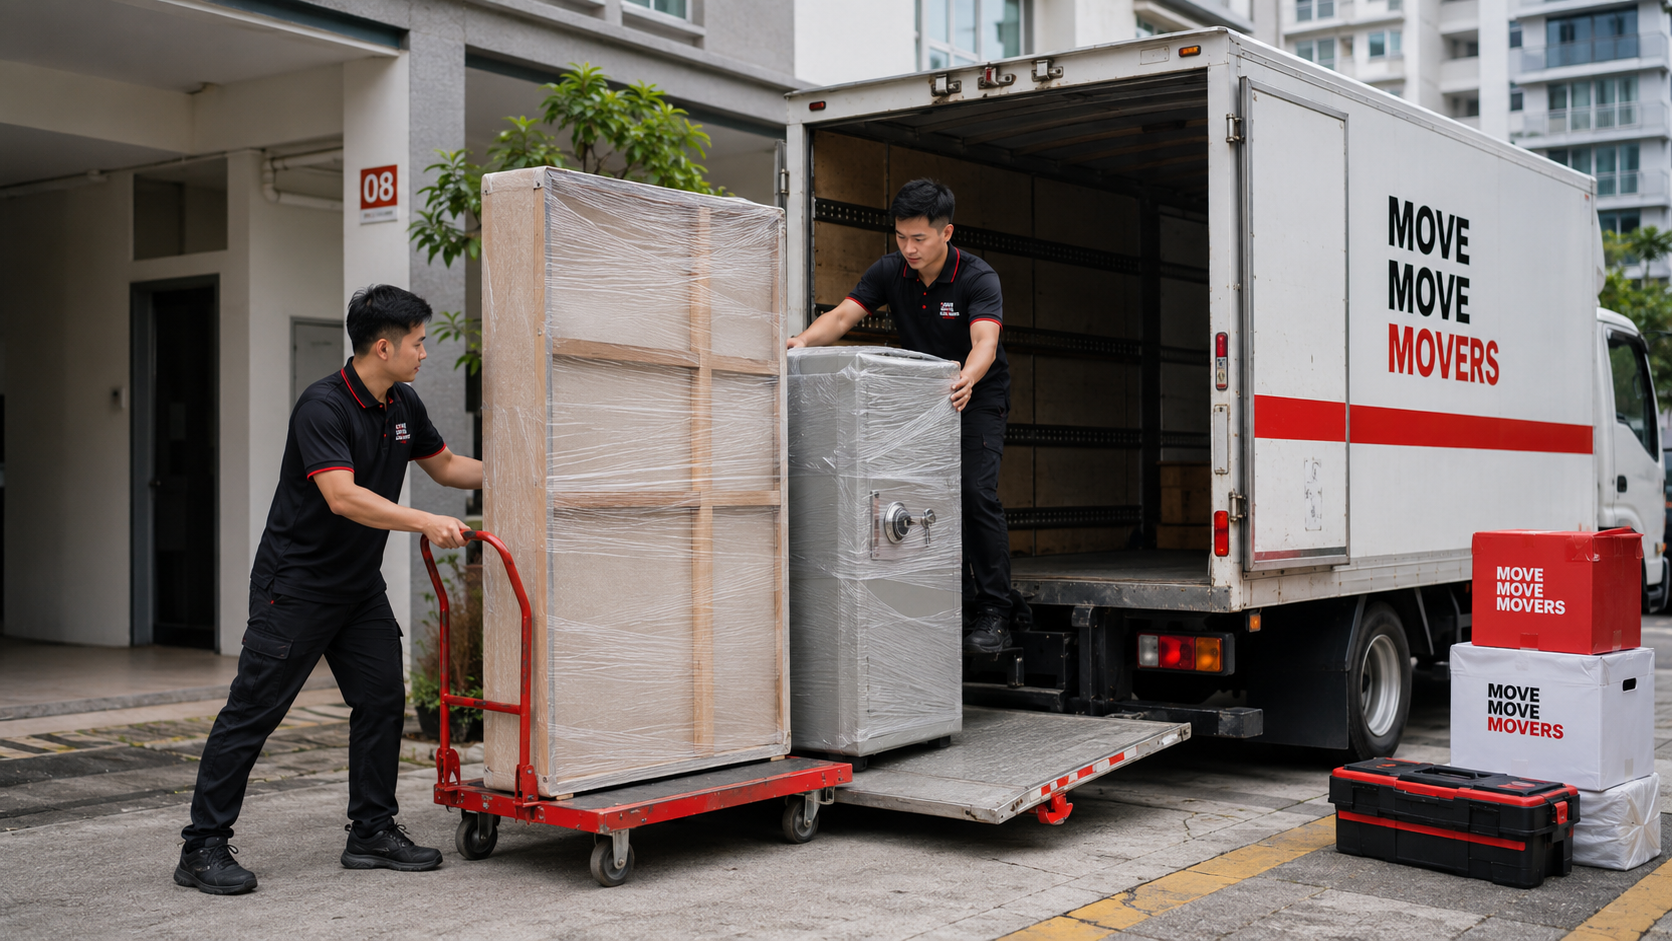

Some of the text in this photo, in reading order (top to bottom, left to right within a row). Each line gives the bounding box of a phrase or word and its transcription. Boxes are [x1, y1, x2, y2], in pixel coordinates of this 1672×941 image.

[363, 171, 394, 204] 08
[1388, 195, 1470, 265] MOVE
[1388, 259, 1470, 324] MOVE
[1388, 323, 1500, 386] MOVERS
[1496, 566, 1544, 582] MOVE
[1496, 581, 1544, 598] MOVE
[1496, 597, 1566, 615] MOVERS
[1488, 683, 1540, 703] MOVE
[1488, 700, 1540, 720] MOVE
[1488, 717, 1564, 739] MOVERS
